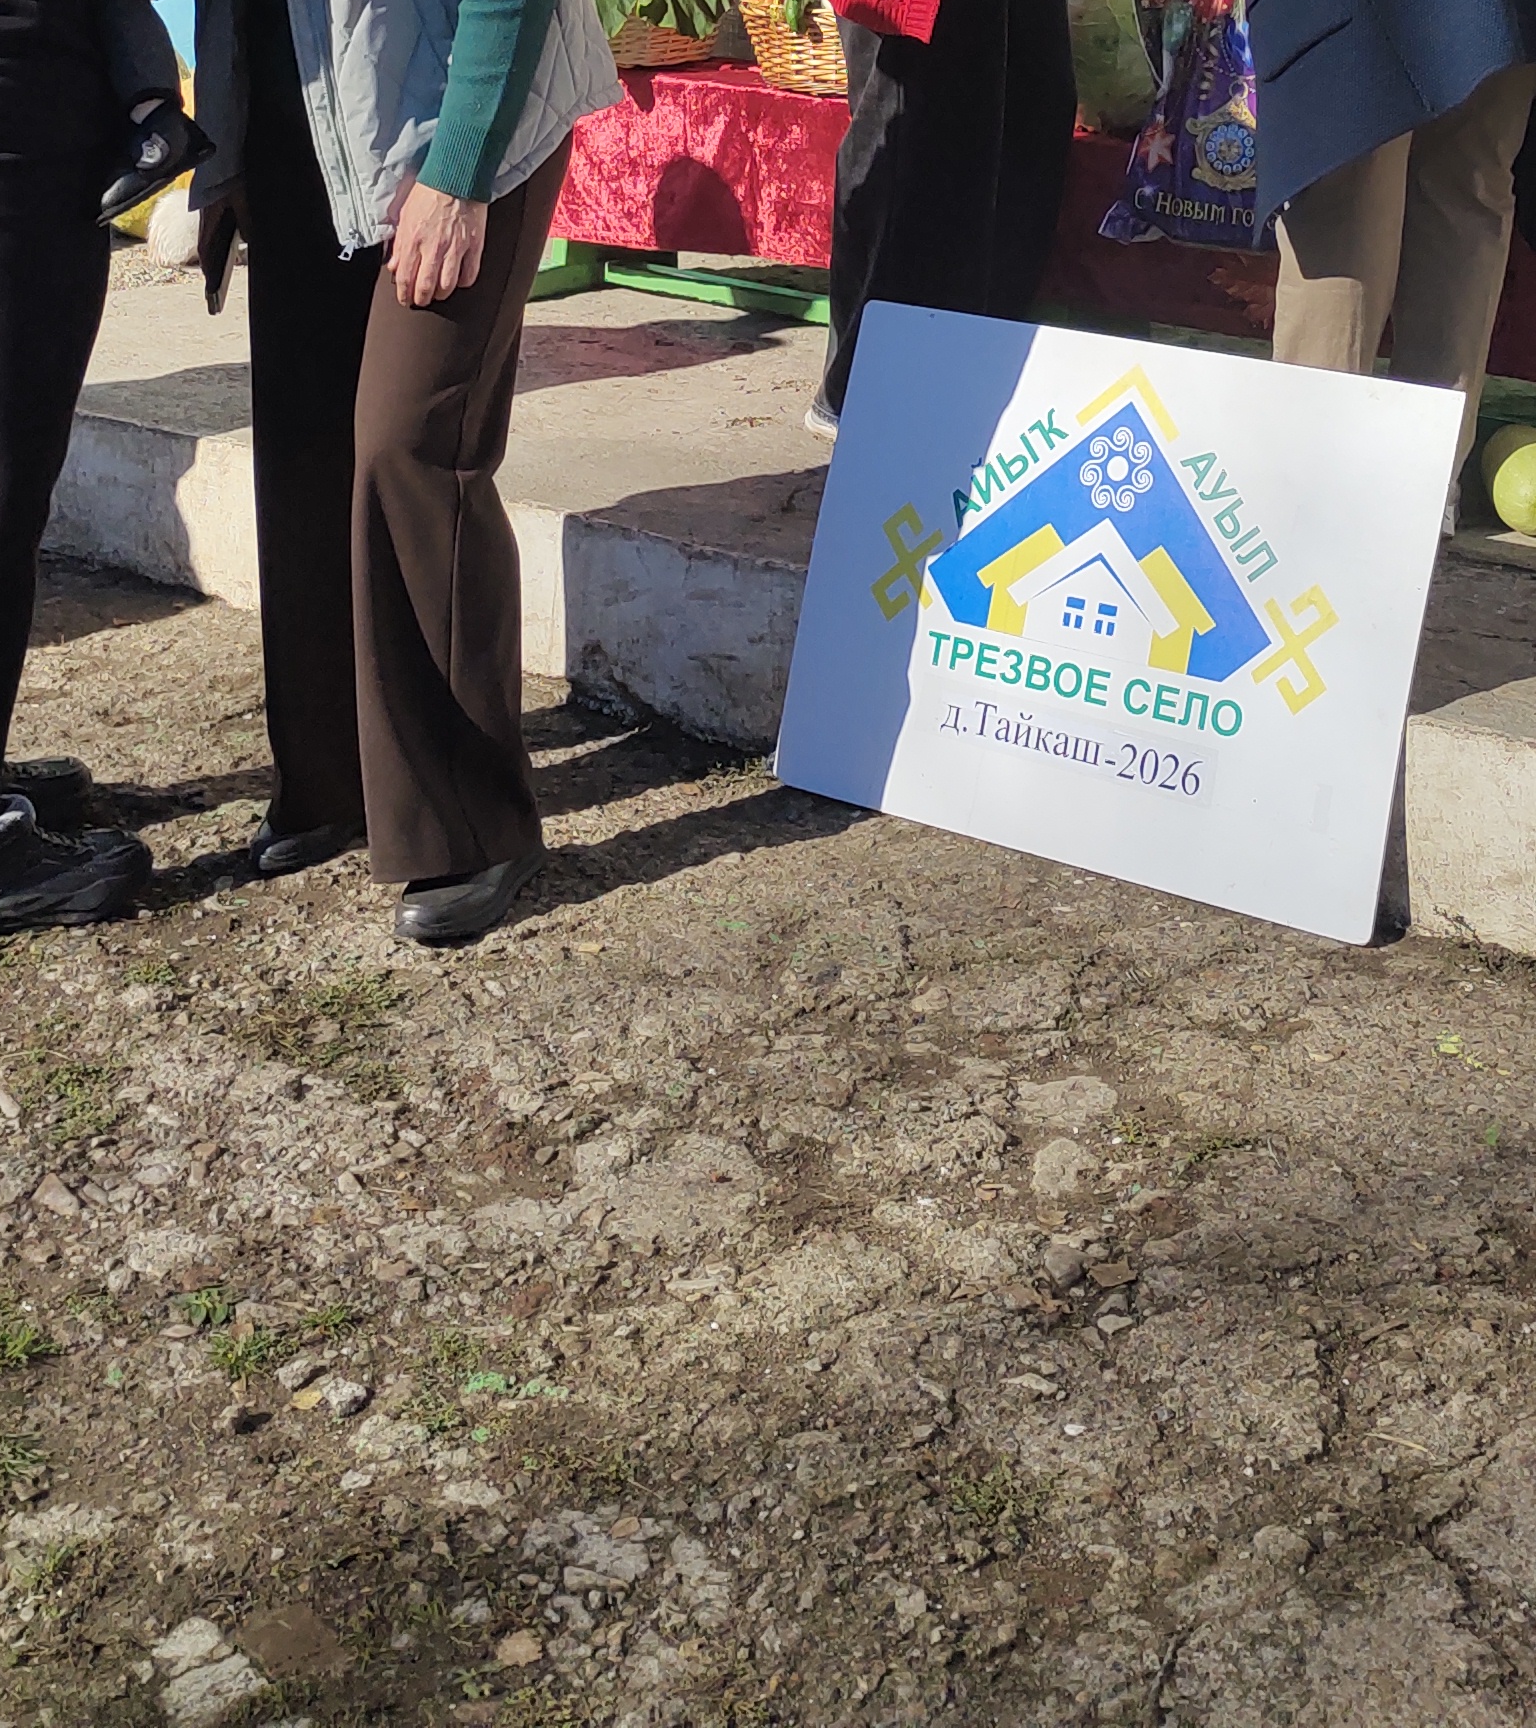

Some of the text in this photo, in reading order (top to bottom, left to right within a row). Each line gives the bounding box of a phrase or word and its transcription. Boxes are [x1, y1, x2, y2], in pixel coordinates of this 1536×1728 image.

[1179, 450, 1279, 584] АУЫЛ
[927, 630, 1244, 739] ТРЕЗВОЕ СЕЛО
[939, 700, 1202, 797] д.Тайкаш-2026
